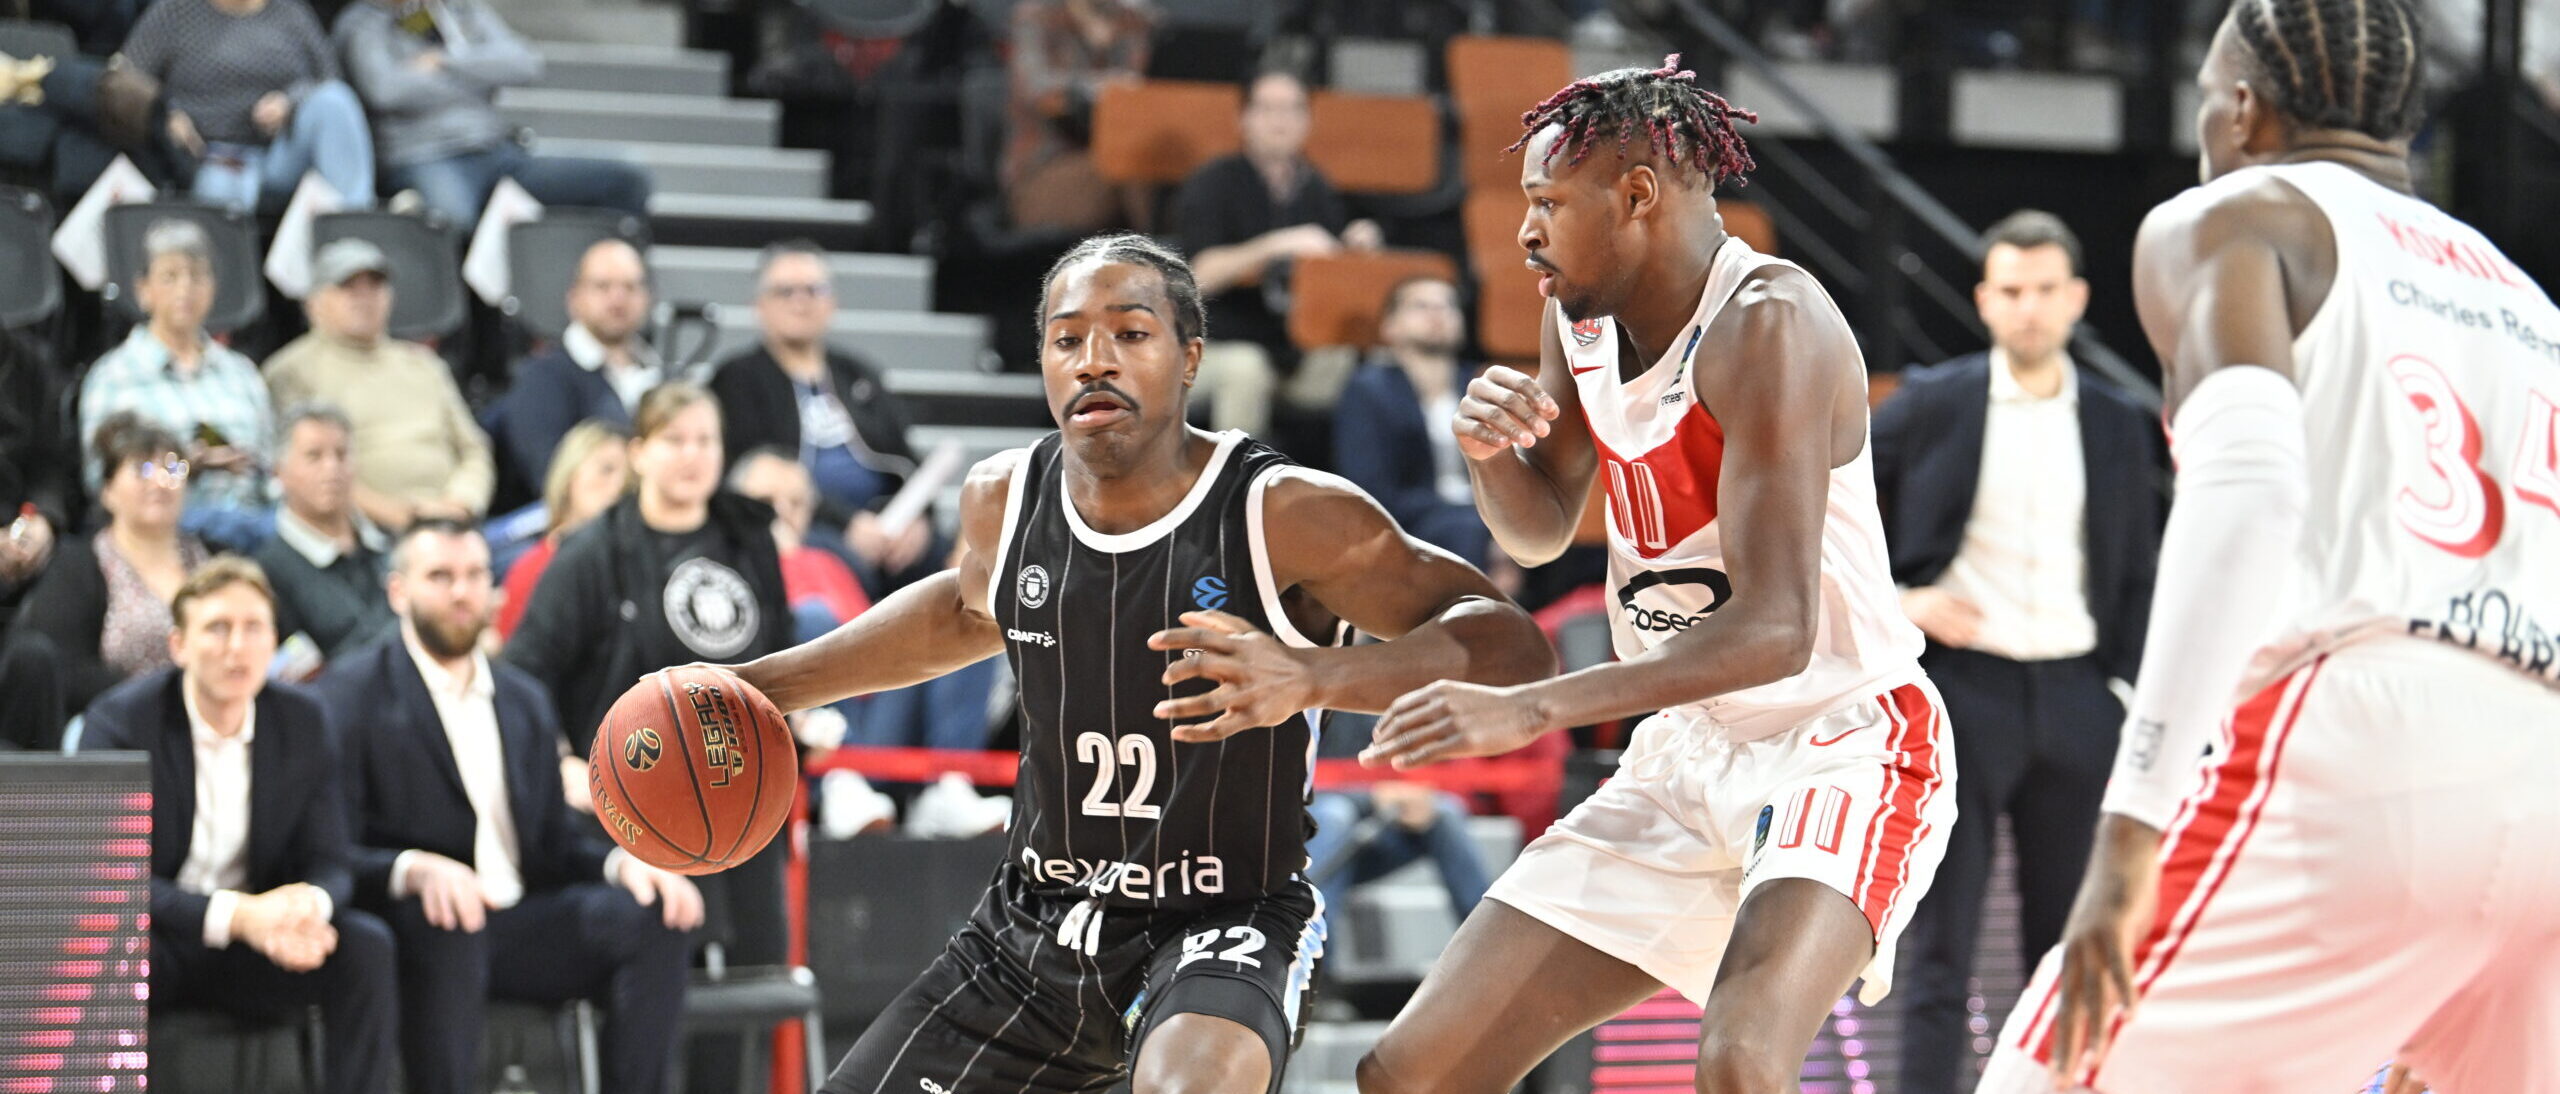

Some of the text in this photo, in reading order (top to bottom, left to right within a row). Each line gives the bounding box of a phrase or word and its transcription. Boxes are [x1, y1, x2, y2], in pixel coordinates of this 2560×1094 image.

[2376, 211, 2538, 300] KOKIL
[1007, 628, 1044, 645] CRAFT
[1076, 731, 1161, 820] 22
[1022, 846, 1224, 900] nexperia
[1176, 926, 1267, 972] 22
